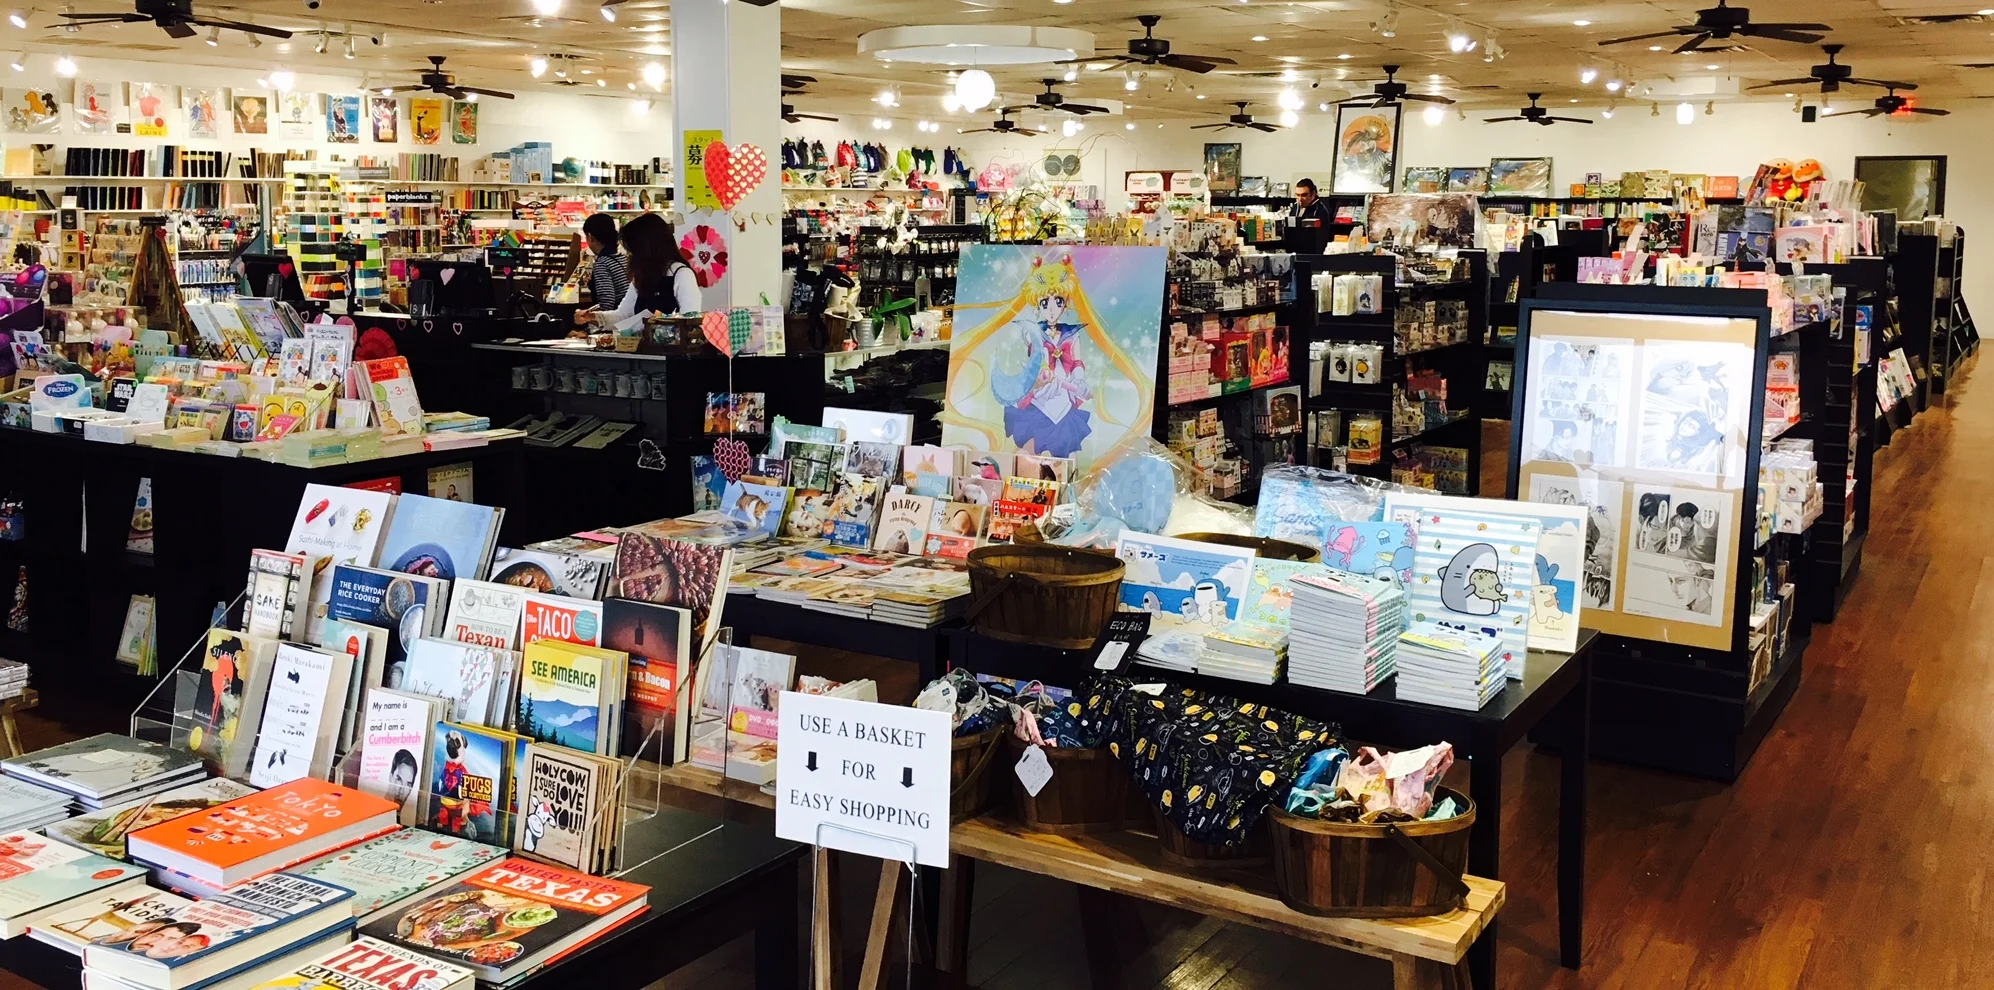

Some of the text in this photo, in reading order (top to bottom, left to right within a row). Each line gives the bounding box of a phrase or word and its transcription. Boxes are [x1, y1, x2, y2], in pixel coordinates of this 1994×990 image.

[687, 144, 703, 165] 募
[387, 193, 428, 202] paperblanks
[47, 385, 74, 394] FROZEN
[114, 390, 134, 399] WARS
[892, 499, 922, 514] DARCY
[337, 589, 381, 604] RICE COOKER
[340, 580, 386, 596] THE EVERYDAY
[537, 606, 572, 639] TACO
[1109, 620, 1144, 632] ECO BAG
[456, 624, 506, 649] Texan
[531, 660, 548, 678] SEE
[550, 662, 596, 689] AMERICA
[372, 700, 408, 711] My name is
[370, 723, 382, 731] and
[799, 714, 832, 734] USE
[837, 721, 849, 737] A
[855, 722, 926, 749] BASKET
[368, 732, 421, 745] Cumberbitch
[535, 760, 586, 792] HOLY COW,
[841, 759, 876, 780] FOR
[462, 774, 492, 795] PUGS
[534, 776, 584, 812] I SURE LOVE
[543, 788, 555, 800] DO
[790, 789, 931, 830] EASY SHOPPING
[263, 875, 334, 897] THE LIBERAL
[481, 868, 622, 908] TEXAS
[504, 862, 621, 893] UNITED TASTES
[230, 888, 299, 909] MANIFESTO
[251, 881, 307, 901] REDNECK
[321, 944, 438, 990] TEXAS
[377, 943, 434, 966] LEGENDS
[432, 961, 453, 972] OF
